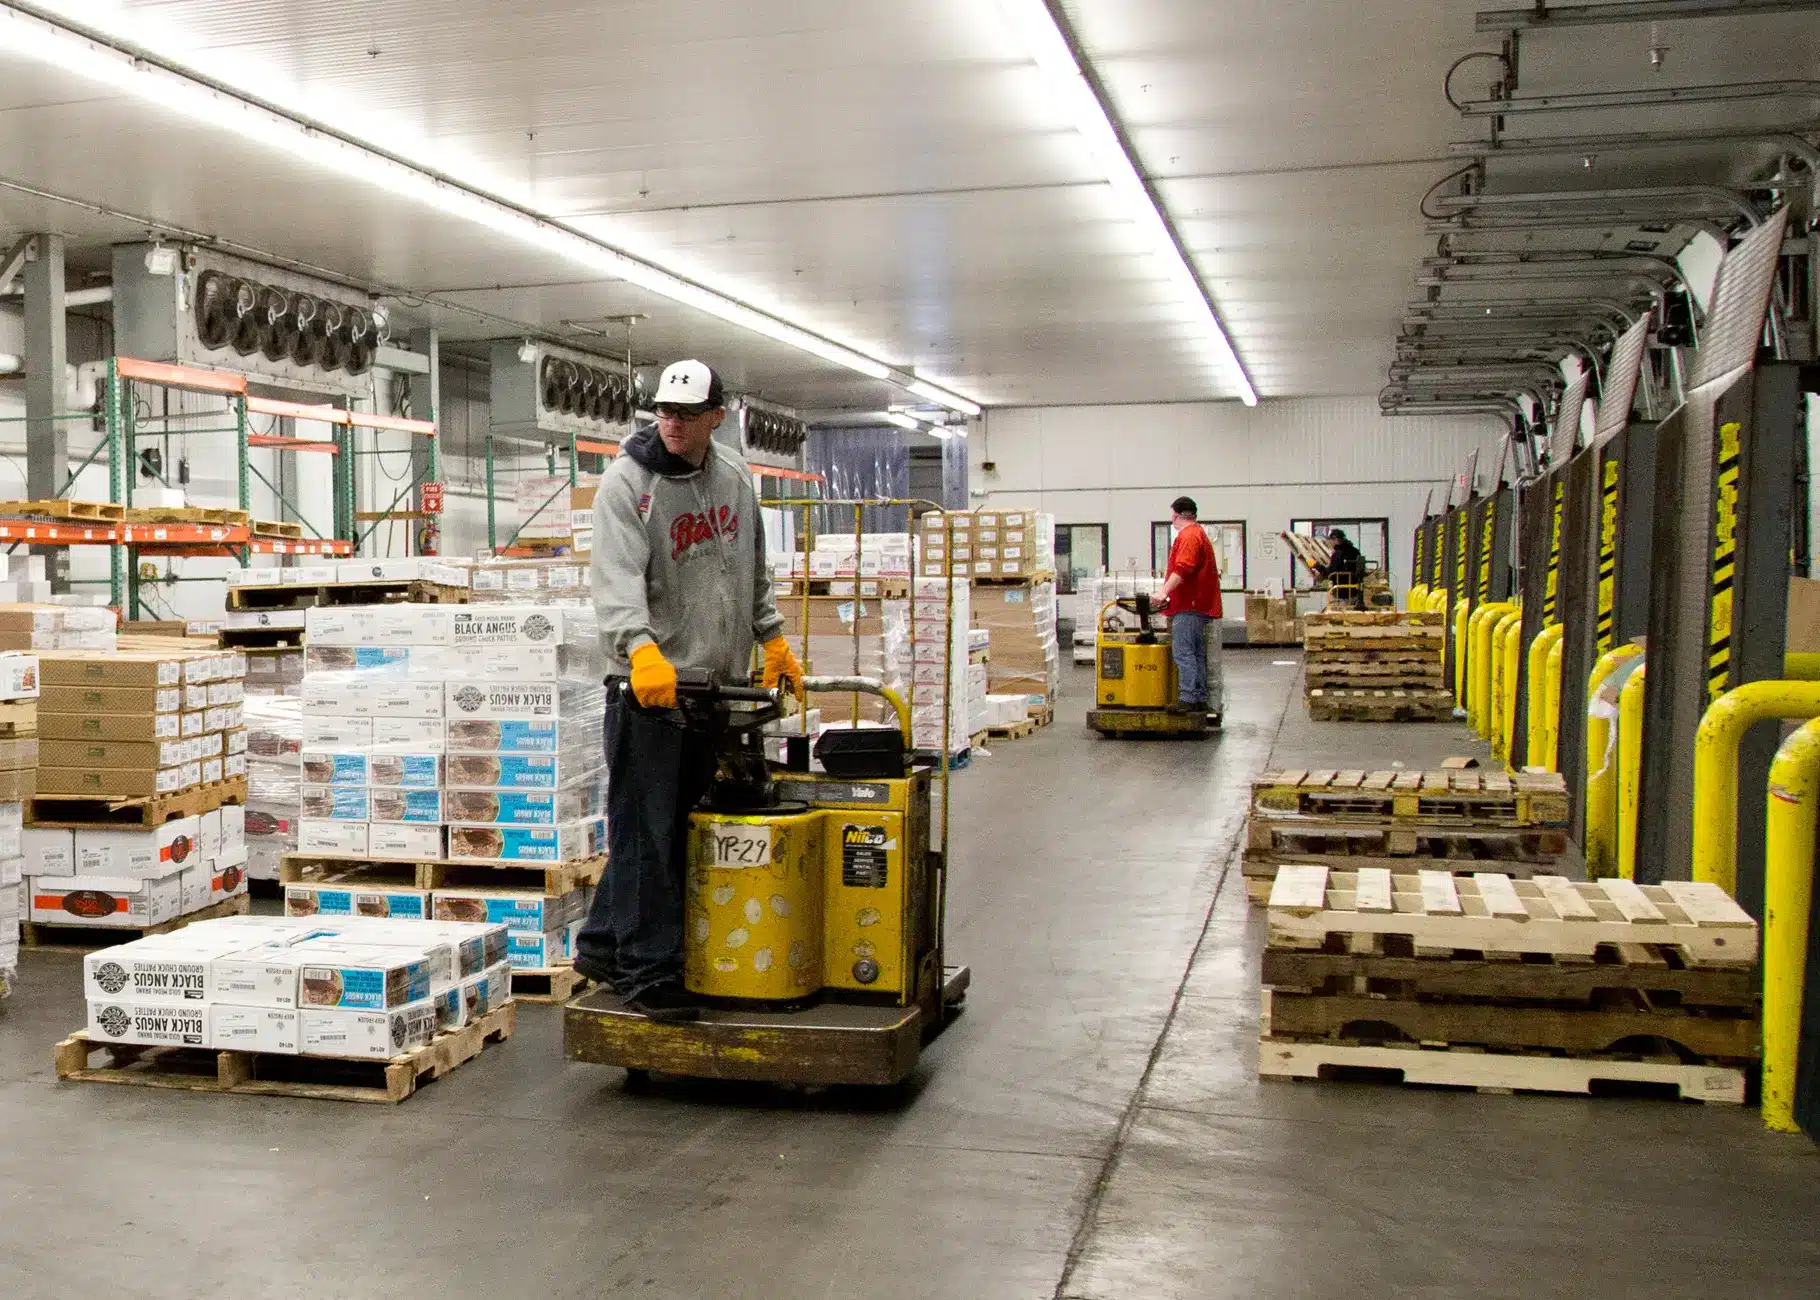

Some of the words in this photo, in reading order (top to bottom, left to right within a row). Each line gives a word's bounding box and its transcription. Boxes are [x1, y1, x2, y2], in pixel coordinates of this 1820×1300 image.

[455, 623, 482, 634] BLACK
[486, 622, 516, 634] ANGUS
[490, 694, 520, 705] ANGUS
[523, 694, 551, 705] BLACK
[852, 787, 876, 798] Yale
[716, 836, 767, 862] YP-29
[134, 963, 156, 971] PATTIES
[158, 964, 177, 972] CHUCK
[178, 964, 204, 973] GROUND
[134, 973, 168, 987] ANGUS
[172, 974, 204, 988] BLACK
[134, 1007, 156, 1016] PATTIES
[158, 1008, 177, 1017] CHUCK
[178, 1009, 202, 1018] GROUND
[135, 1017, 168, 1032] ANGUS
[172, 1019, 202, 1033] BLACK
